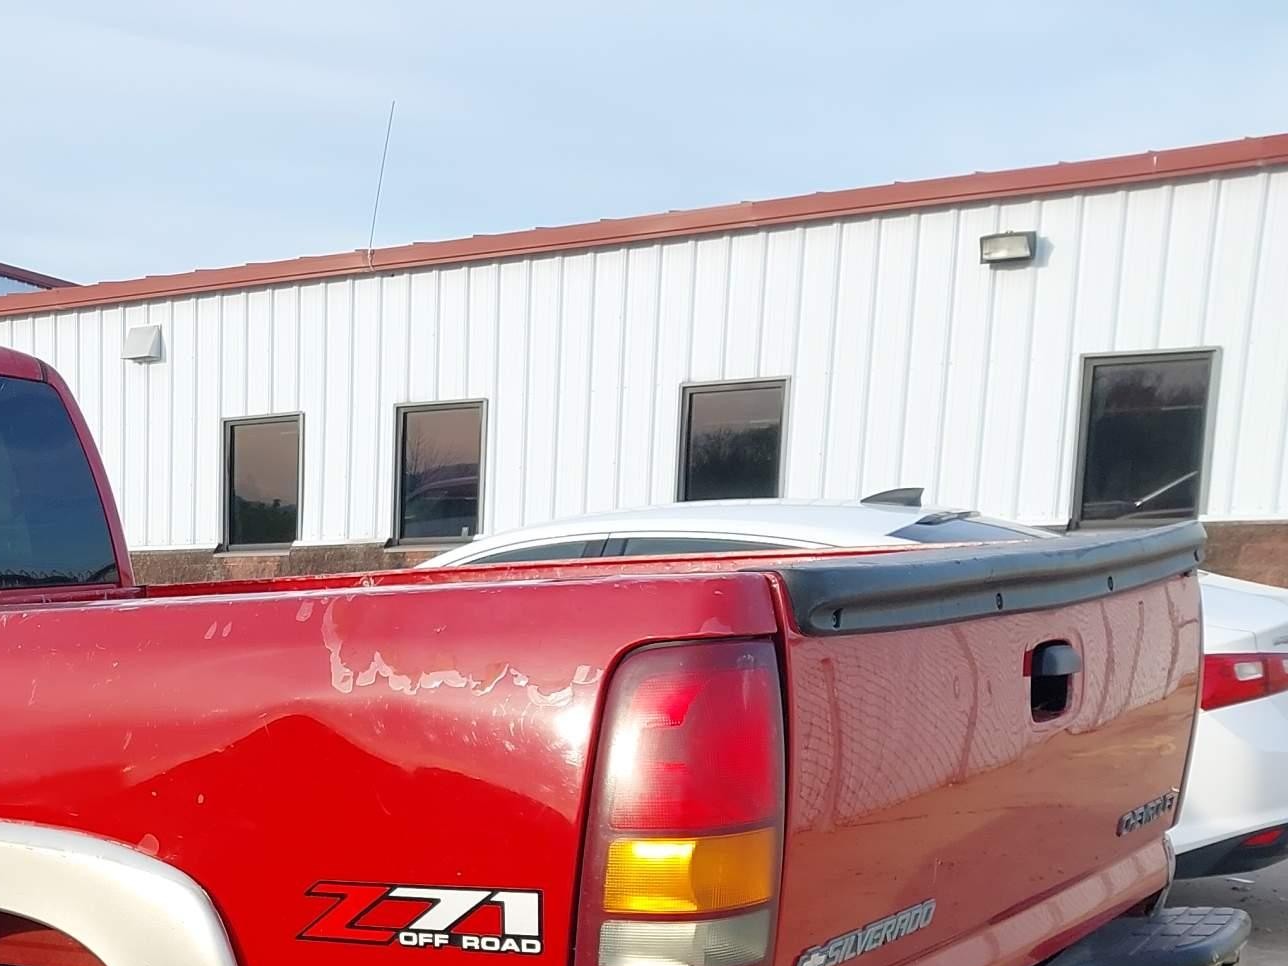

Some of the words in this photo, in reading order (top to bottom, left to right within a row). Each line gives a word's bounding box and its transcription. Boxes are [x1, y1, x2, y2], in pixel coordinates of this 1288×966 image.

[296, 879, 544, 945] Z71
[398, 931, 450, 948] OFF
[461, 935, 542, 954] ROAD
